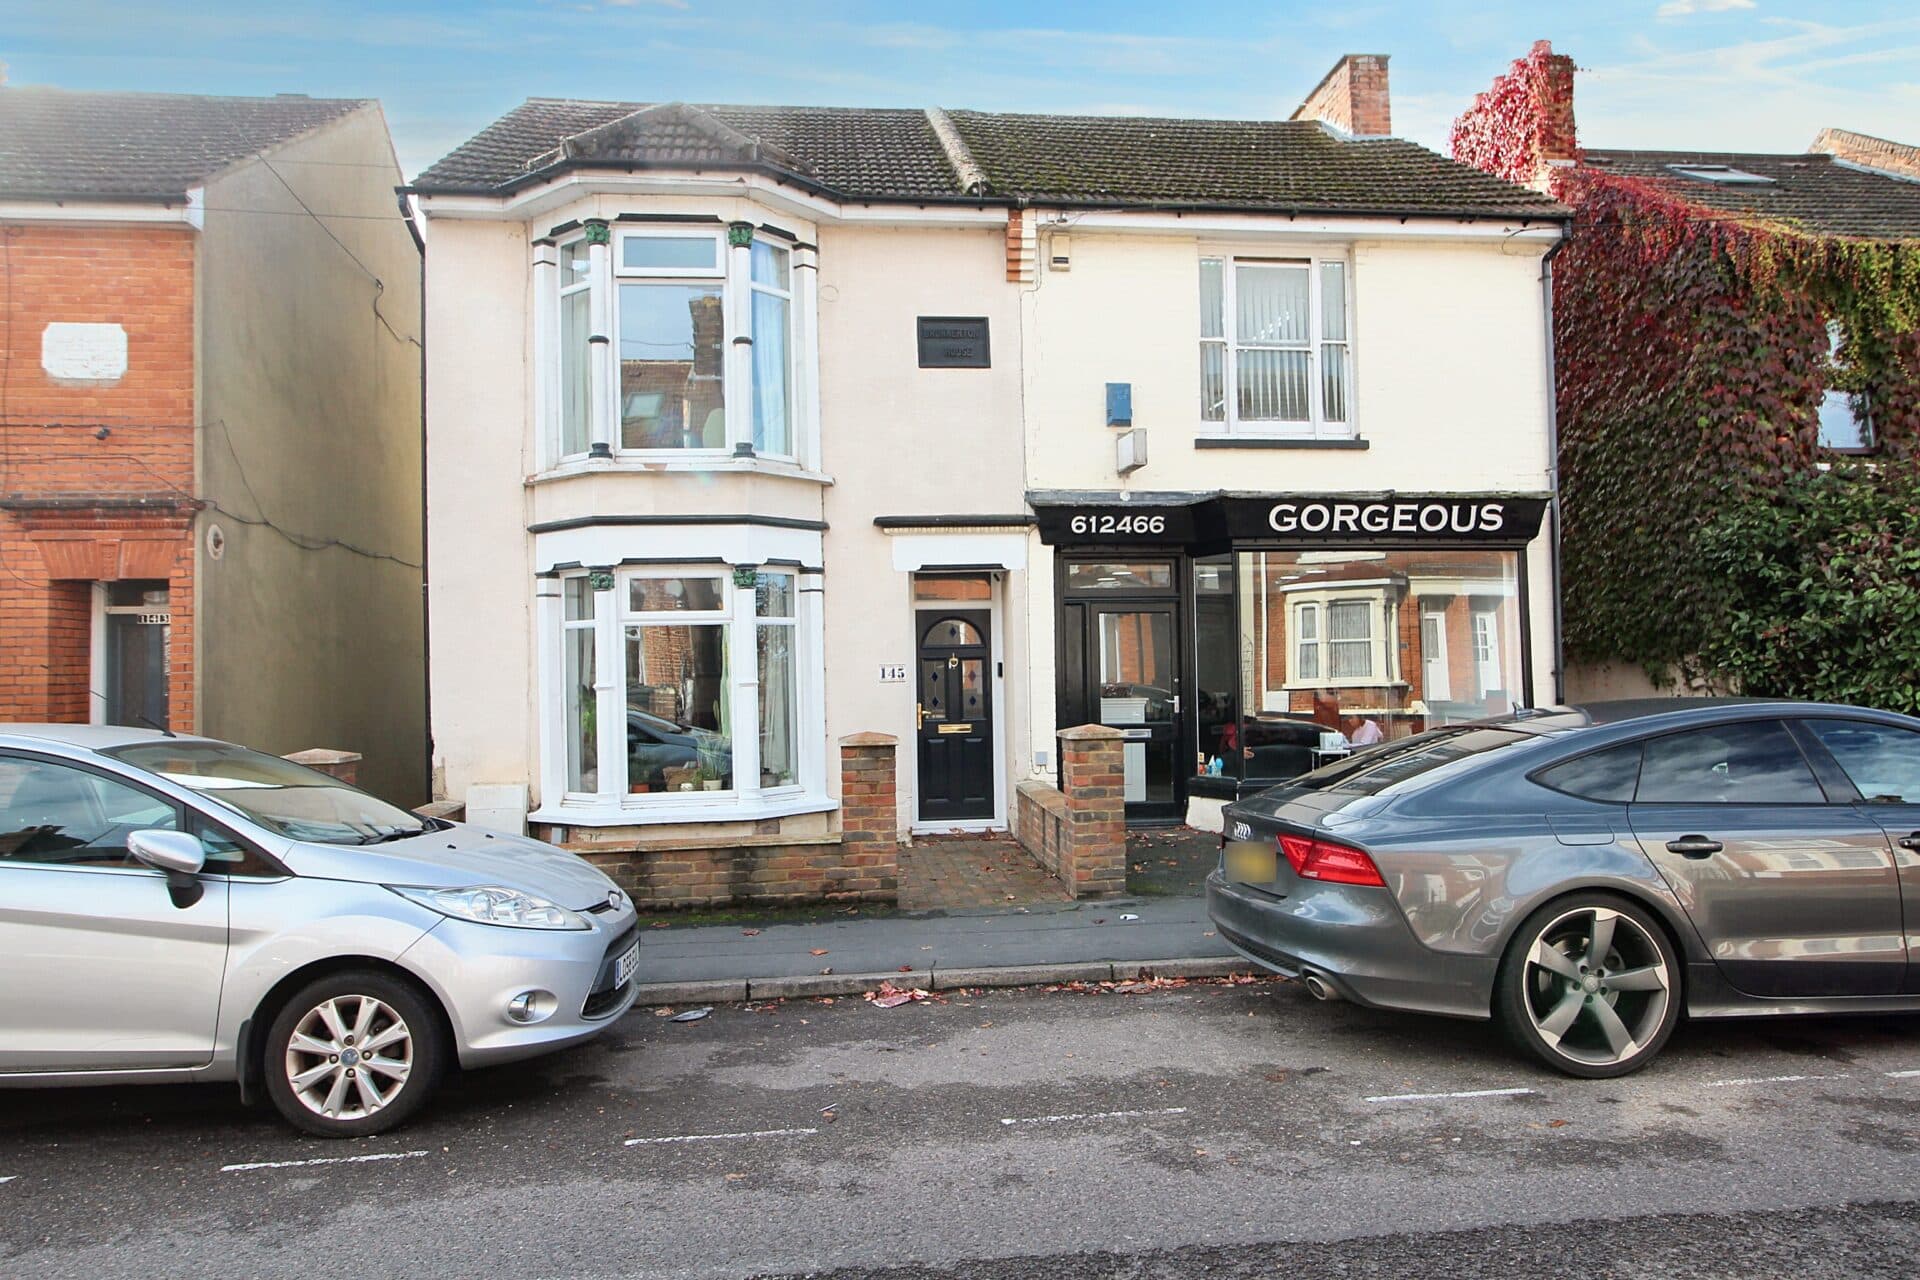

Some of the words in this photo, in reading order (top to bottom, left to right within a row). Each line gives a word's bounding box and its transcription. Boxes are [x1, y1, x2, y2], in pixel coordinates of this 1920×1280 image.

[1070, 515, 1165, 534] 612466
[1268, 503, 1505, 533] GORGEOUS
[138, 614, 170, 624] 143
[880, 666, 905, 679] 145
